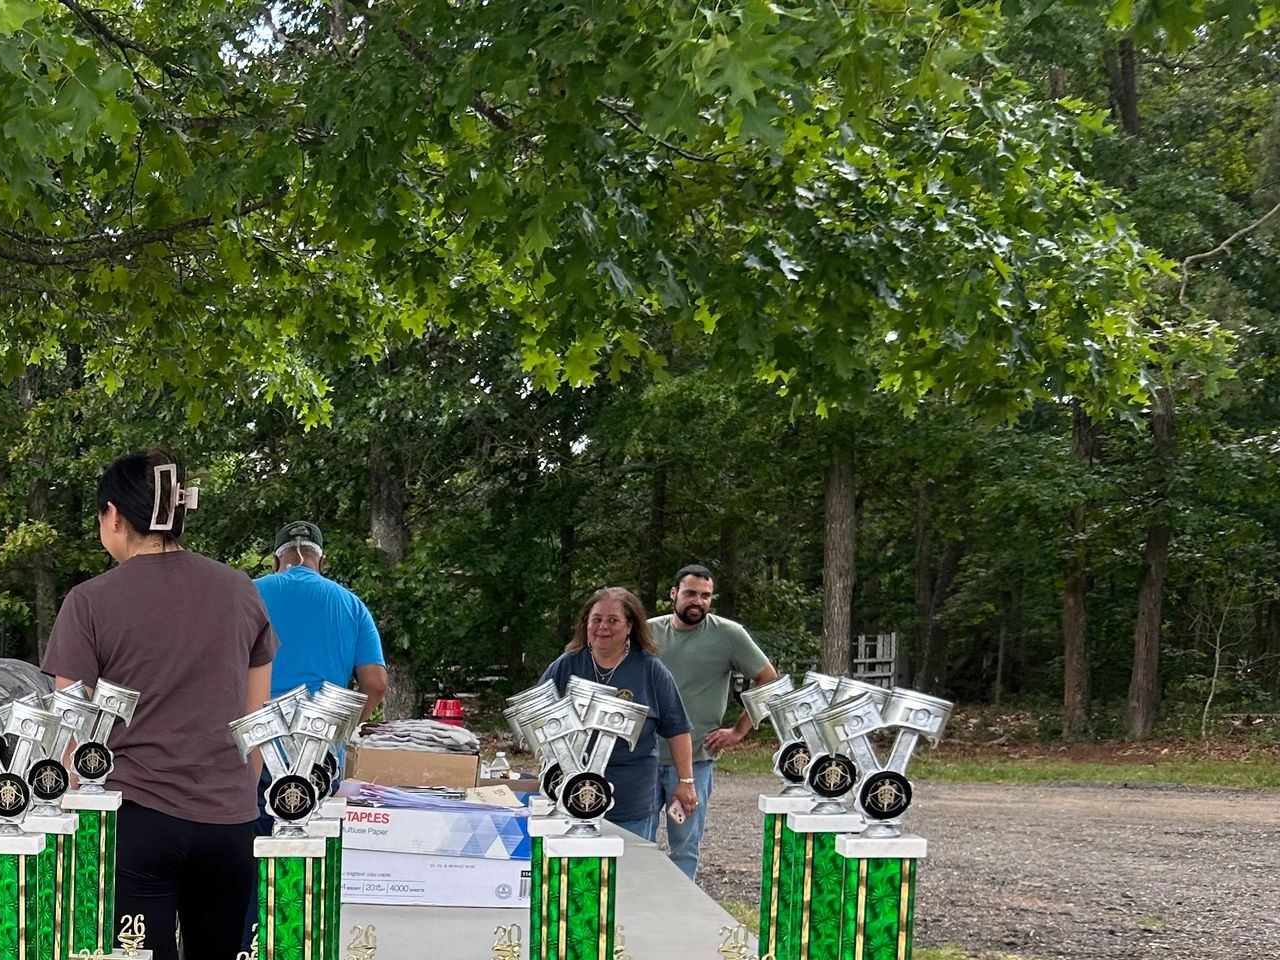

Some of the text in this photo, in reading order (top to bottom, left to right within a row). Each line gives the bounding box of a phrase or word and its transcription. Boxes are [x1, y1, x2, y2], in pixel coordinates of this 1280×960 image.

[344, 811, 390, 824] TAPLES
[368, 828, 388, 836] Paper
[389, 884, 409, 892] 4000
[120, 914, 146, 936] 26
[493, 923, 522, 949] 20
[349, 924, 377, 949] 26
[718, 923, 748, 951] 20
